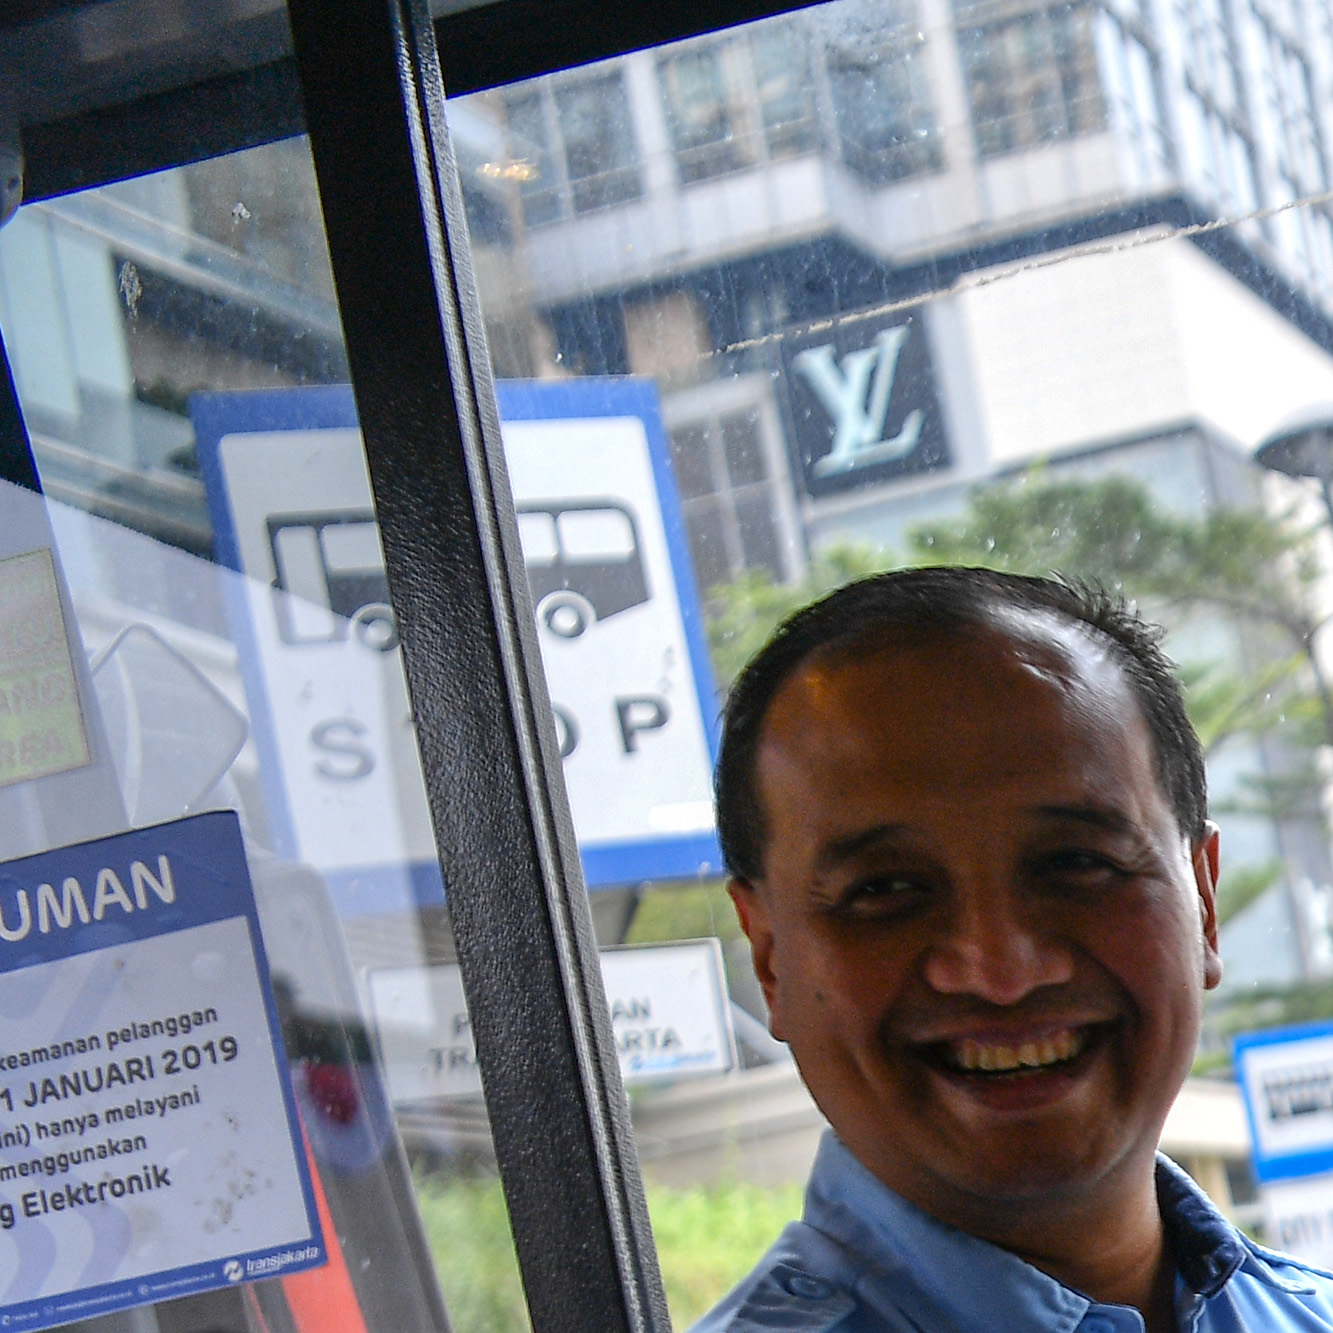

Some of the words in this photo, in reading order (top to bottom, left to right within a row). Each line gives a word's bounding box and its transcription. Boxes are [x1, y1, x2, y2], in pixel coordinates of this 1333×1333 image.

[309, 693, 673, 782] SP
[106, 1007, 218, 1050] pelanggan
[0, 1087, 14, 1111] 1
[24, 1055, 155, 1108] JANUARI
[161, 1036, 238, 1075] 2019
[35, 1112, 99, 1139] hanya
[105, 1085, 200, 1124] melayani
[0, 1134, 147, 1181] menggunakan
[21, 1163, 171, 1218] Elektronik
